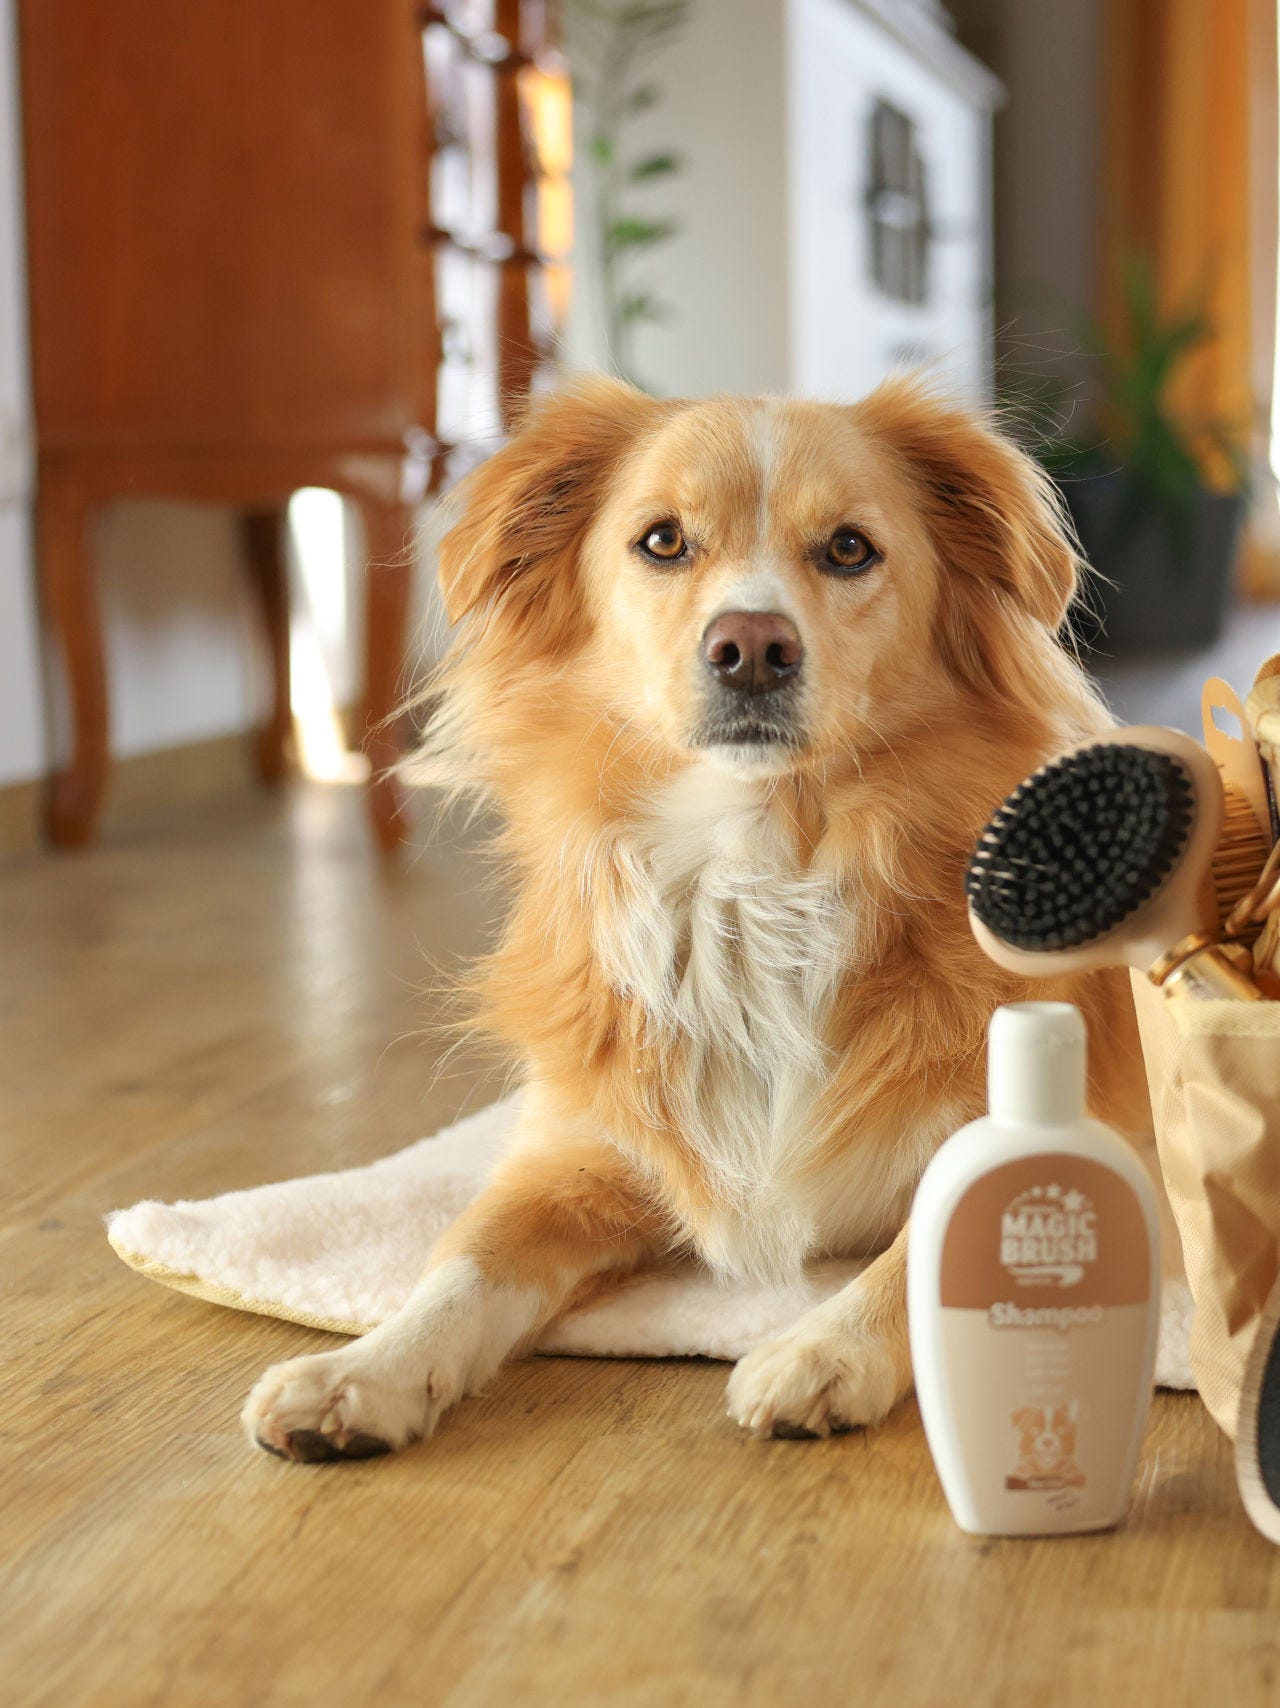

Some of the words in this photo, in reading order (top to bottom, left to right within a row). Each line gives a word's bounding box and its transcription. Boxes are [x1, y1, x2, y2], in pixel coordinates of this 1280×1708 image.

[1001, 1211, 1097, 1238] MAGIC
[1000, 1236, 1097, 1265] BRUSH
[990, 1301, 1104, 1329] Shampoo
